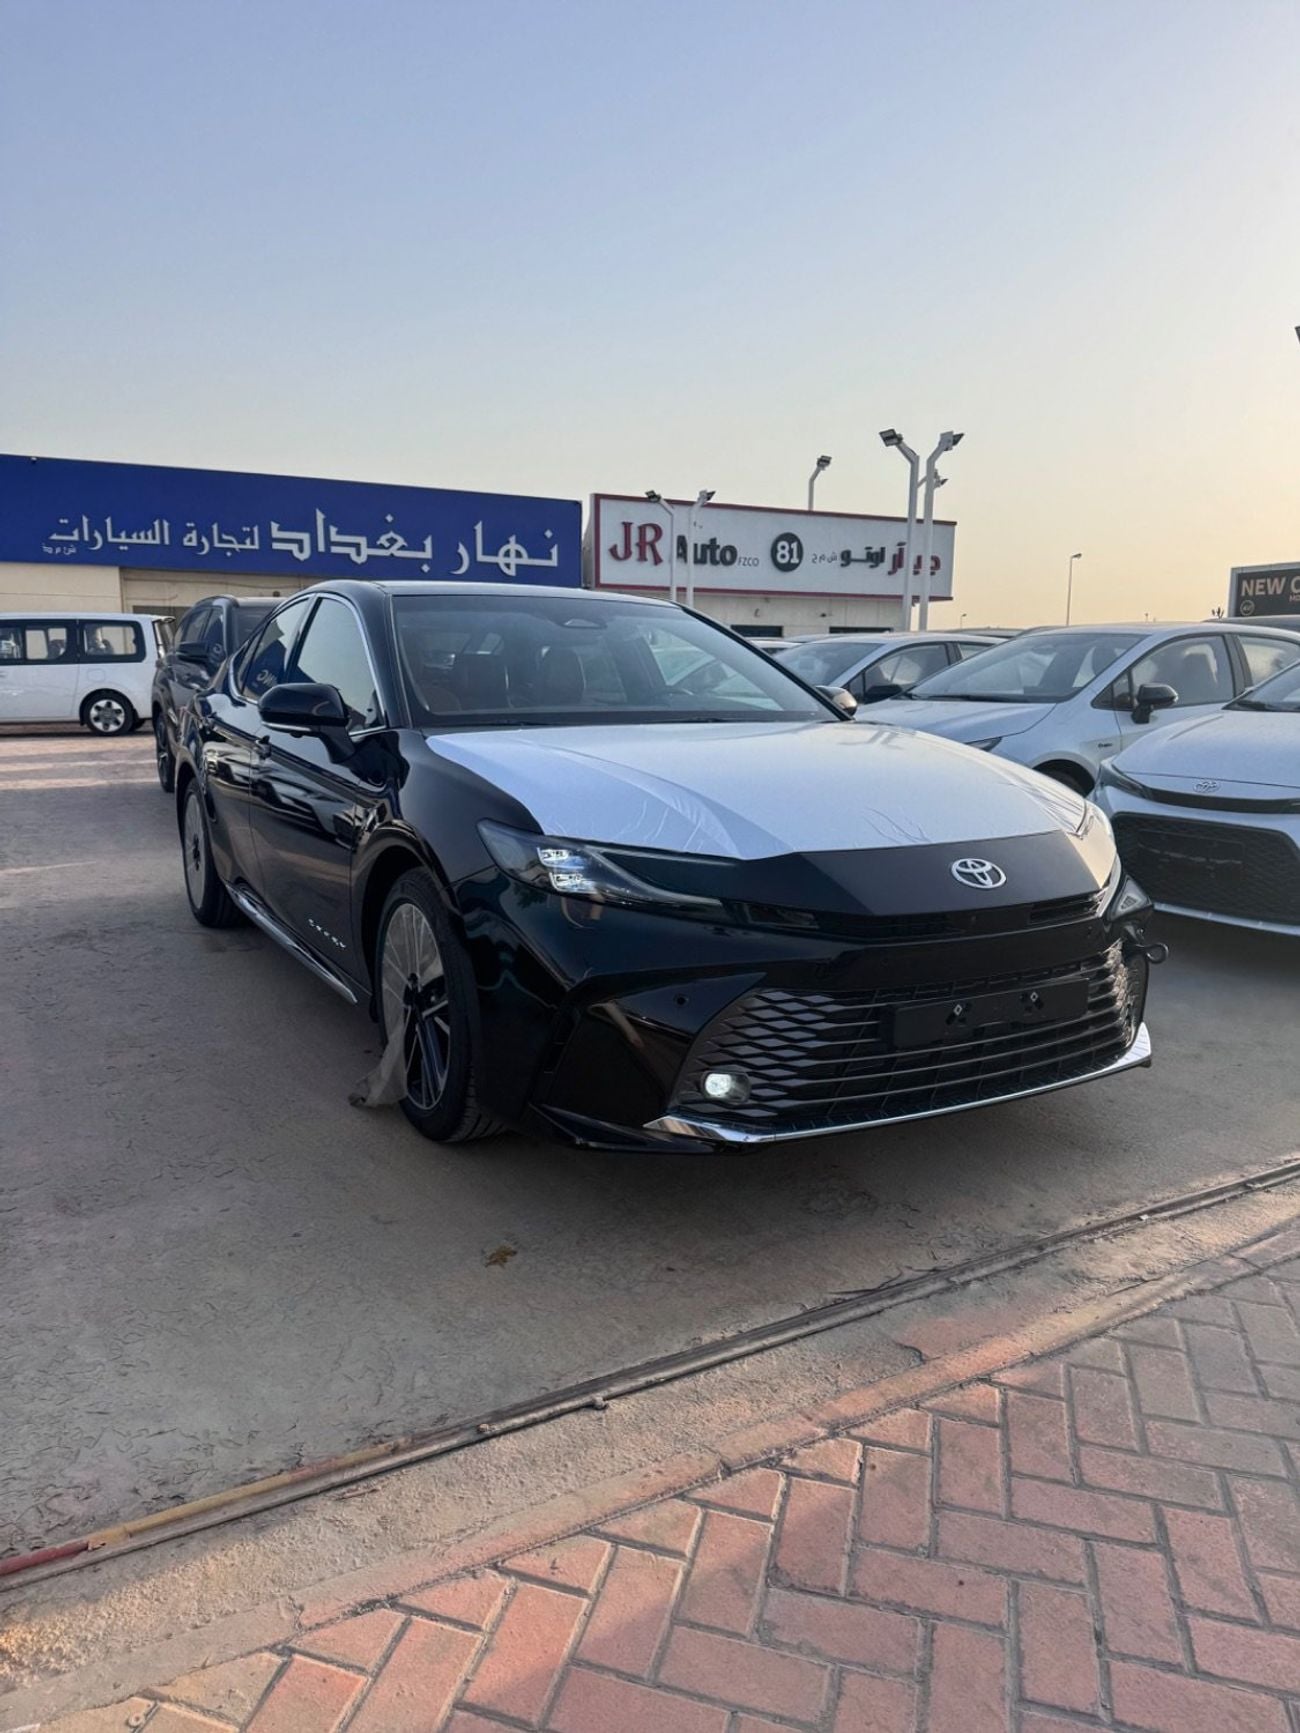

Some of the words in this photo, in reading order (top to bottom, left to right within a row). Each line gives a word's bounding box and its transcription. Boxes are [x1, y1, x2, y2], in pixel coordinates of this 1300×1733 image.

[49, 514, 170, 551] السيارات
[182, 522, 260, 557] لتجارة
[270, 508, 433, 574] بغداد
[450, 520, 559, 577] نهار
[608, 521, 664, 566] JR
[671, 534, 738, 566] Auto
[738, 556, 760, 567] FZCO
[776, 540, 800, 564] 81
[1241, 576, 1287, 597] NEW
